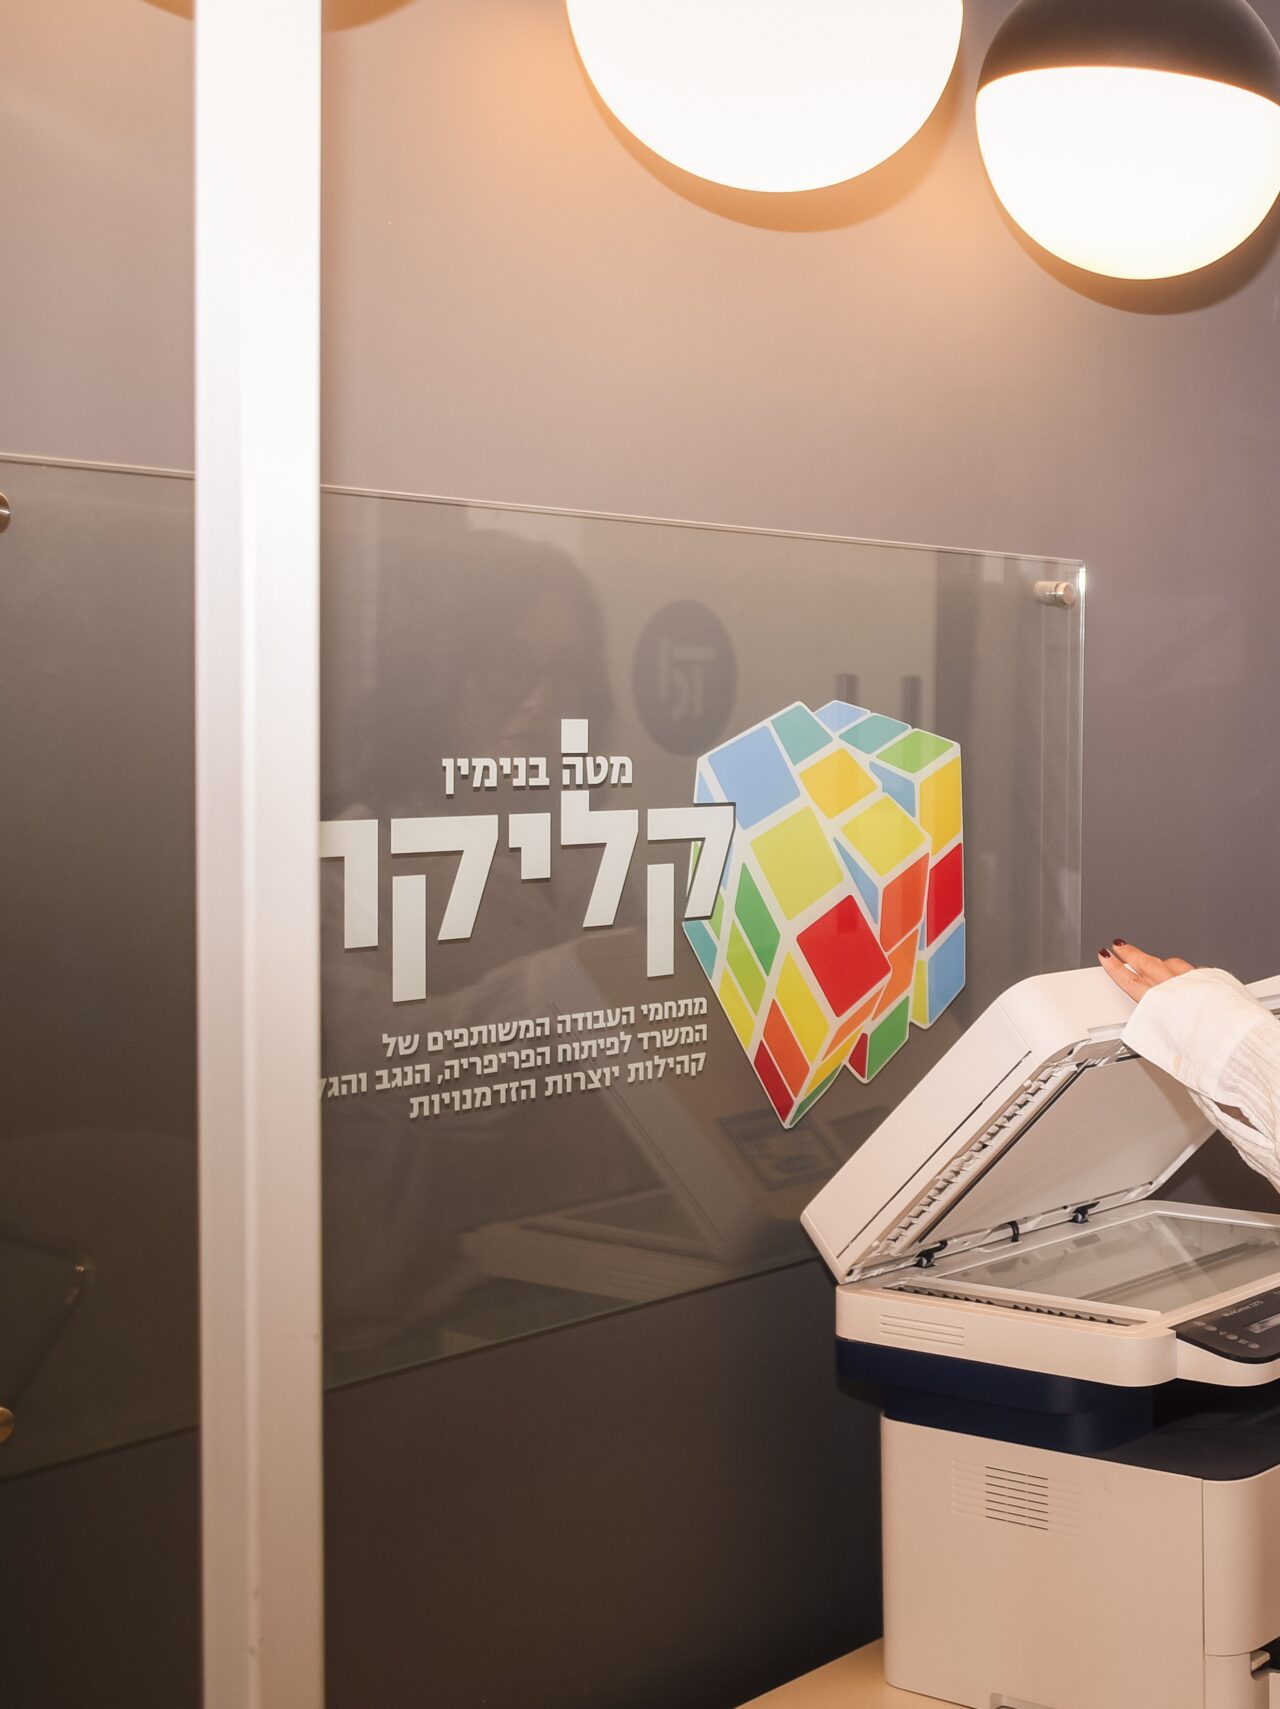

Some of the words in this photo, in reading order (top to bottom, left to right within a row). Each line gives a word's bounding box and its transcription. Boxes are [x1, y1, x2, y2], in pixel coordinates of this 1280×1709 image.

[442, 757, 549, 796] בנימין
[561, 756, 633, 786] מטה
[557, 1006, 635, 1034] העבודה
[641, 997, 707, 1021] מתחמי
[382, 1033, 420, 1058] של
[427, 1017, 550, 1052] המשותפים
[557, 1032, 632, 1063] לפיתוח
[638, 1024, 707, 1050] המשרד
[375, 1063, 431, 1090] הנגב
[437, 1045, 551, 1085] הפריפריה,
[628, 1050, 707, 1082] קהילות
[545, 1069, 620, 1097] יוצרות
[409, 1079, 536, 1119] הזדמנויות
